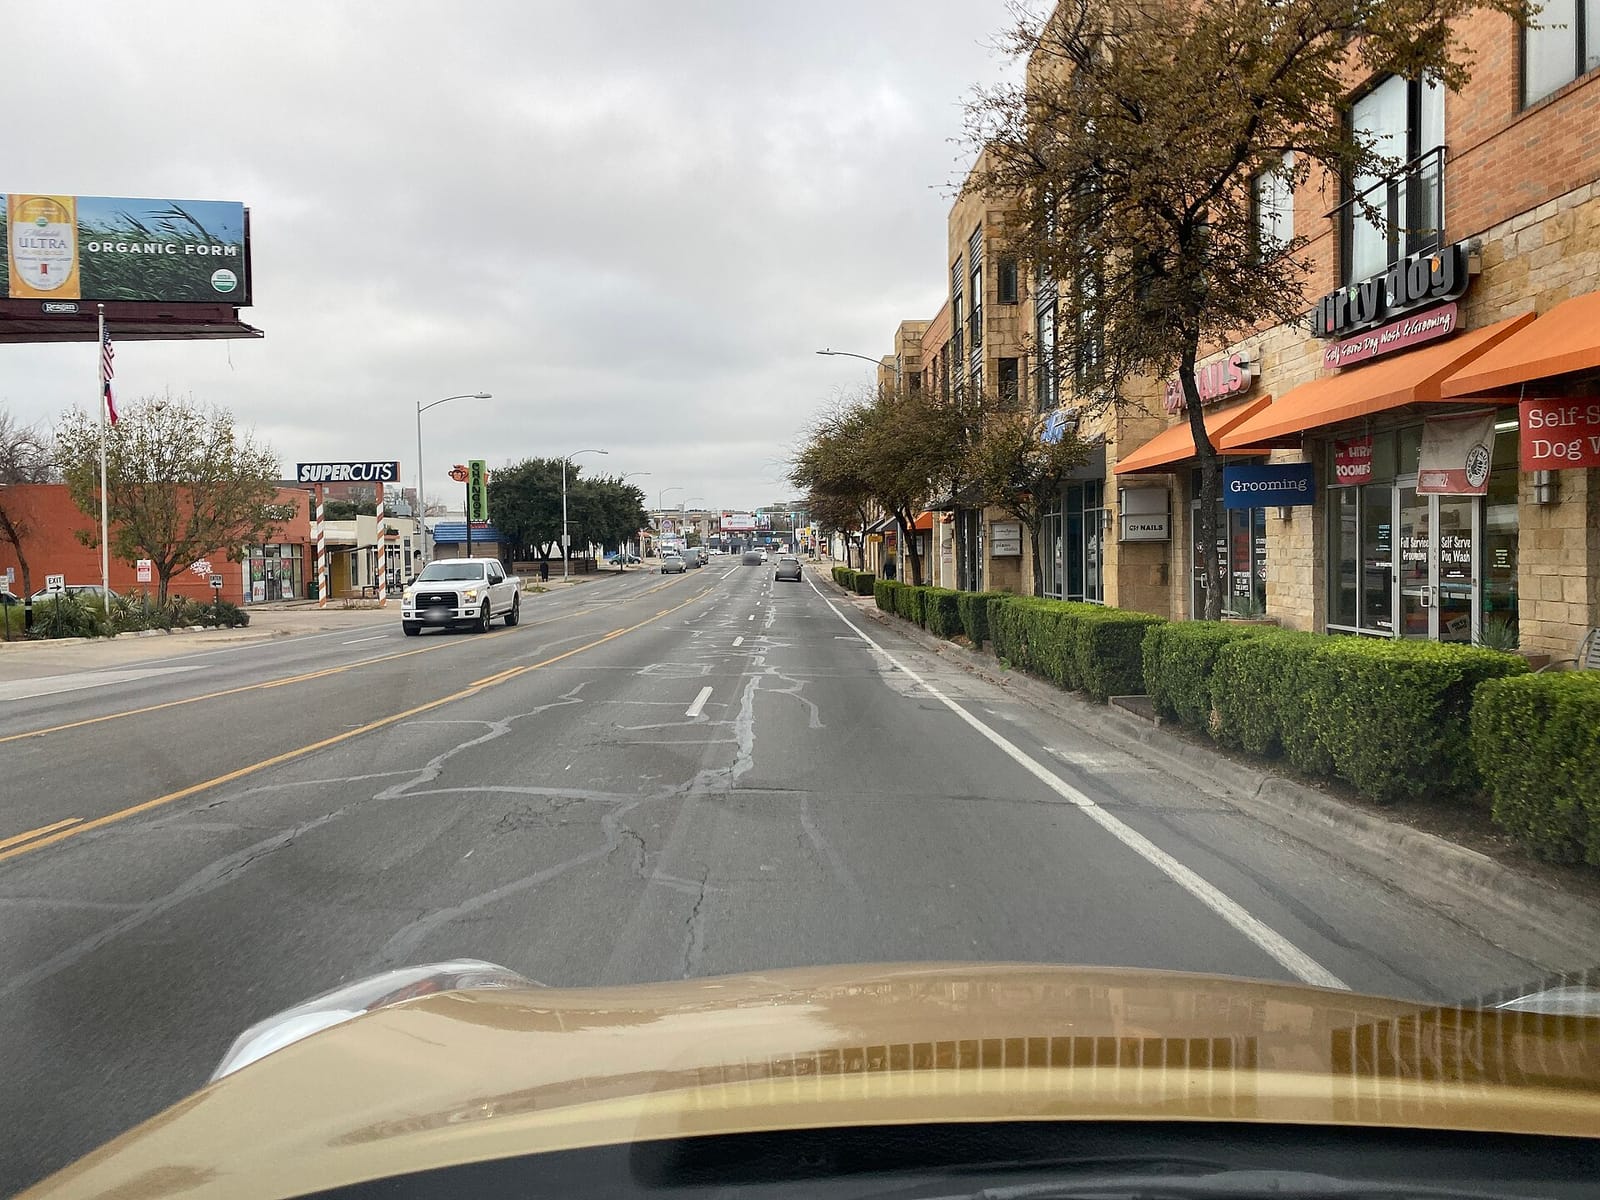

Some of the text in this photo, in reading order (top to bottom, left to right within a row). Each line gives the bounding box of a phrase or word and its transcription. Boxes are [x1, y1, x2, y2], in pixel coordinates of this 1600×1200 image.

[18, 238, 68, 249] ULTRA
[87, 241, 238, 256] ORGANIC FORM
[1311, 248, 1462, 338] dirty dog
[1326, 345, 1340, 365] Self
[1364, 336, 1379, 354] Dog
[1381, 325, 1402, 345] Wash
[1410, 312, 1451, 335] Grooming
[1531, 438, 1582, 461] Dog
[300, 463, 392, 482] SUPERCUTS
[471, 462, 482, 519] CHANGOS
[1230, 479, 1308, 493] Grooming
[1400, 536, 1410, 549] Full
[1410, 536, 1430, 549] Service
[1440, 536, 1452, 549] Self
[1453, 536, 1471, 549] Serve
[1402, 549, 1471, 564] Grooming Dog Wash
[48, 576, 62, 585] EXIT
